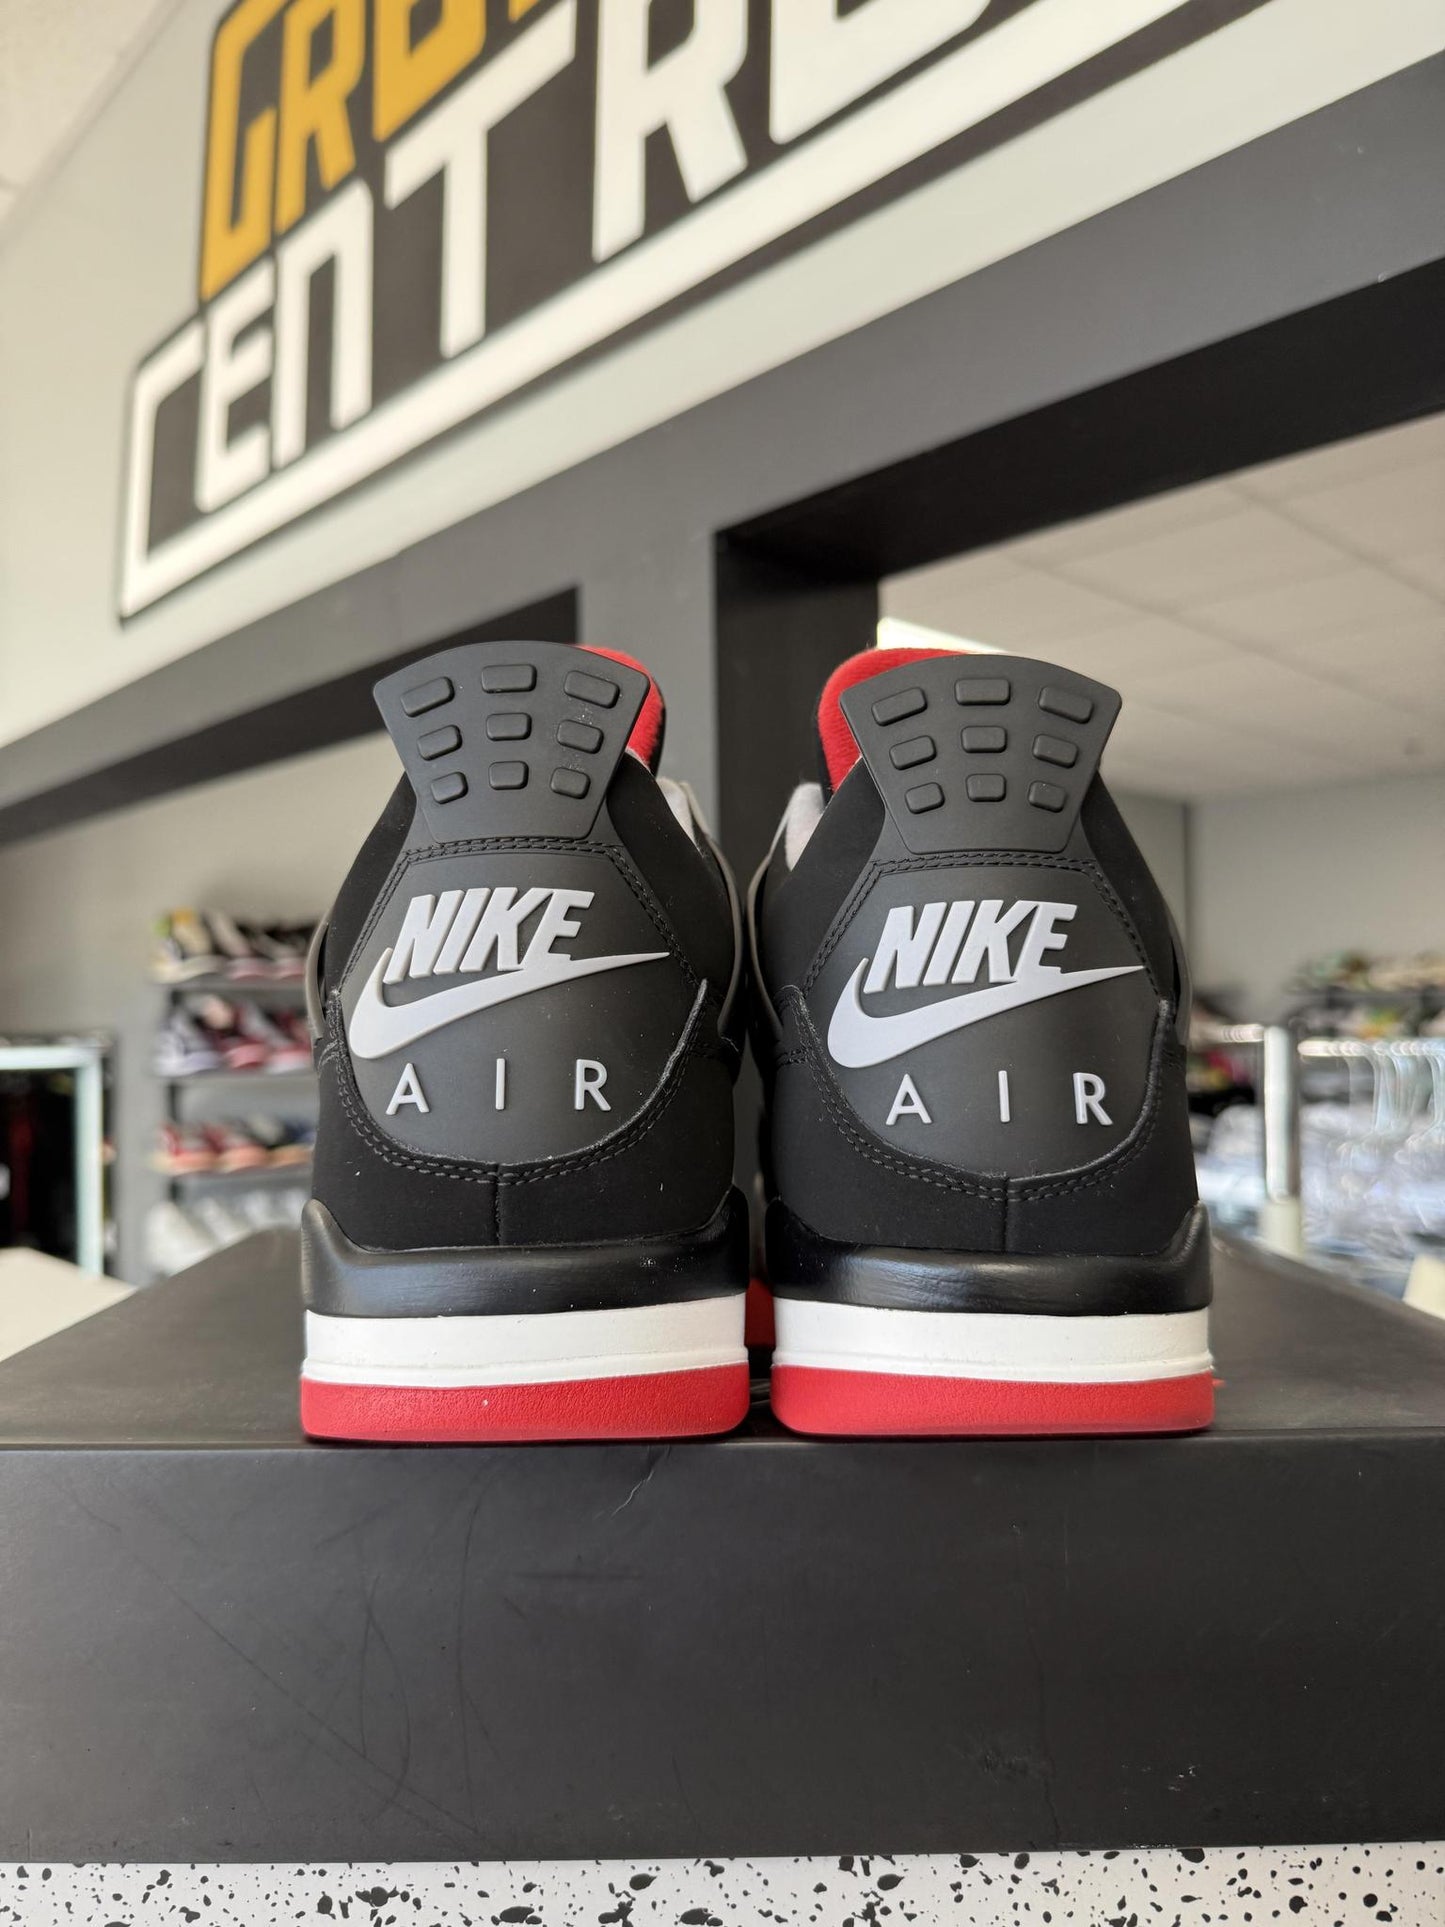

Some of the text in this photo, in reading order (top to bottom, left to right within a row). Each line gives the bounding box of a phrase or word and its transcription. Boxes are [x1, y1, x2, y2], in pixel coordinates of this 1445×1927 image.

[383, 887, 595, 985] NIKE
[863, 899, 1078, 994] NIKE
[385, 1057, 612, 1116] AIR
[885, 1070, 1114, 1127] AIR
